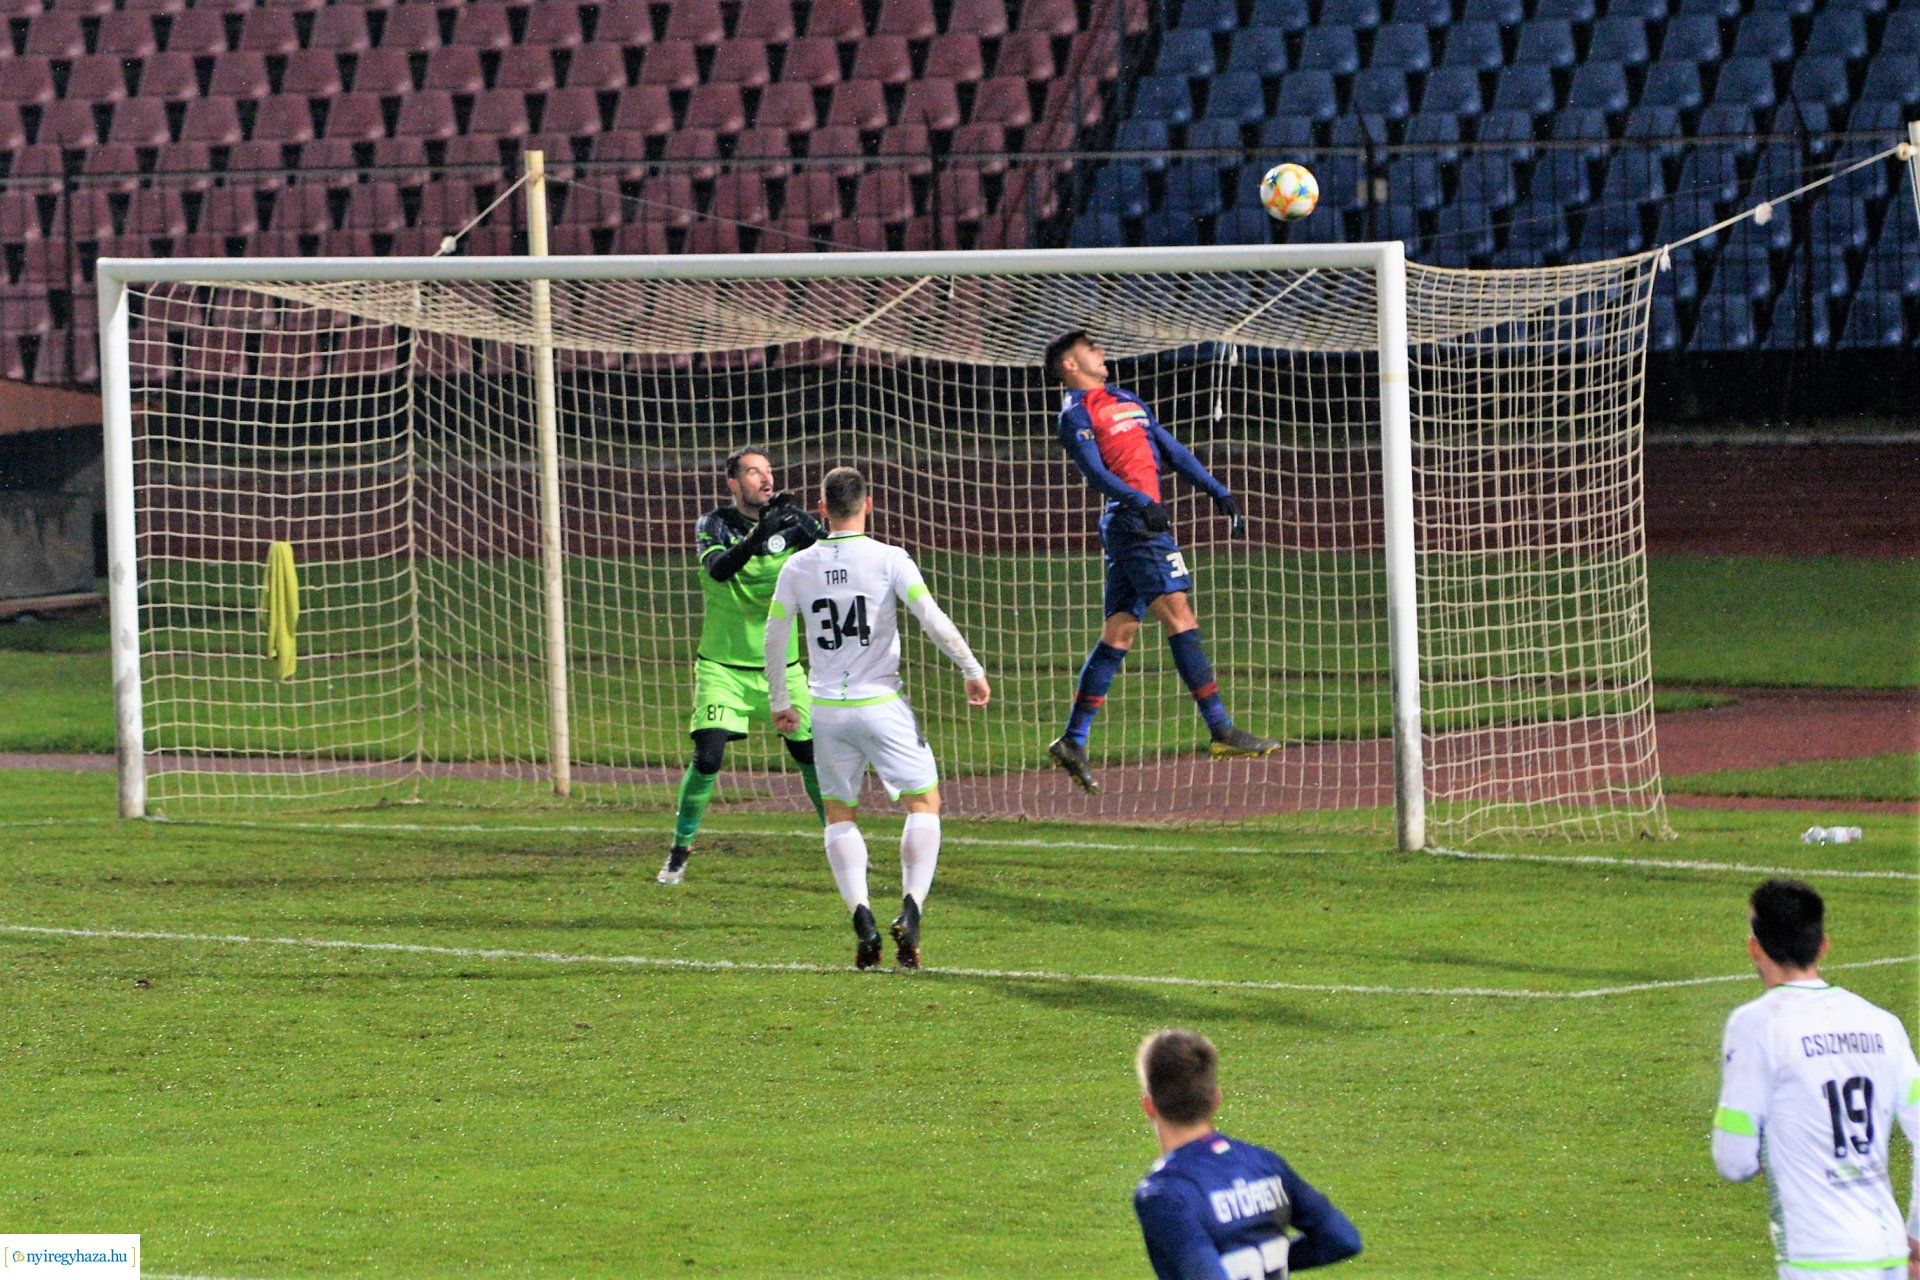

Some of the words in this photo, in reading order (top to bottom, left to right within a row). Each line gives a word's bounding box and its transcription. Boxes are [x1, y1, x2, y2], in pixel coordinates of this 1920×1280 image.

[824, 569, 848, 586] TAR
[1166, 551, 1189, 578] 3
[811, 594, 871, 650] 34
[707, 704, 725, 722] 87
[1801, 1032, 1885, 1058] CSIZMADIA
[1821, 1076, 1875, 1159] 19
